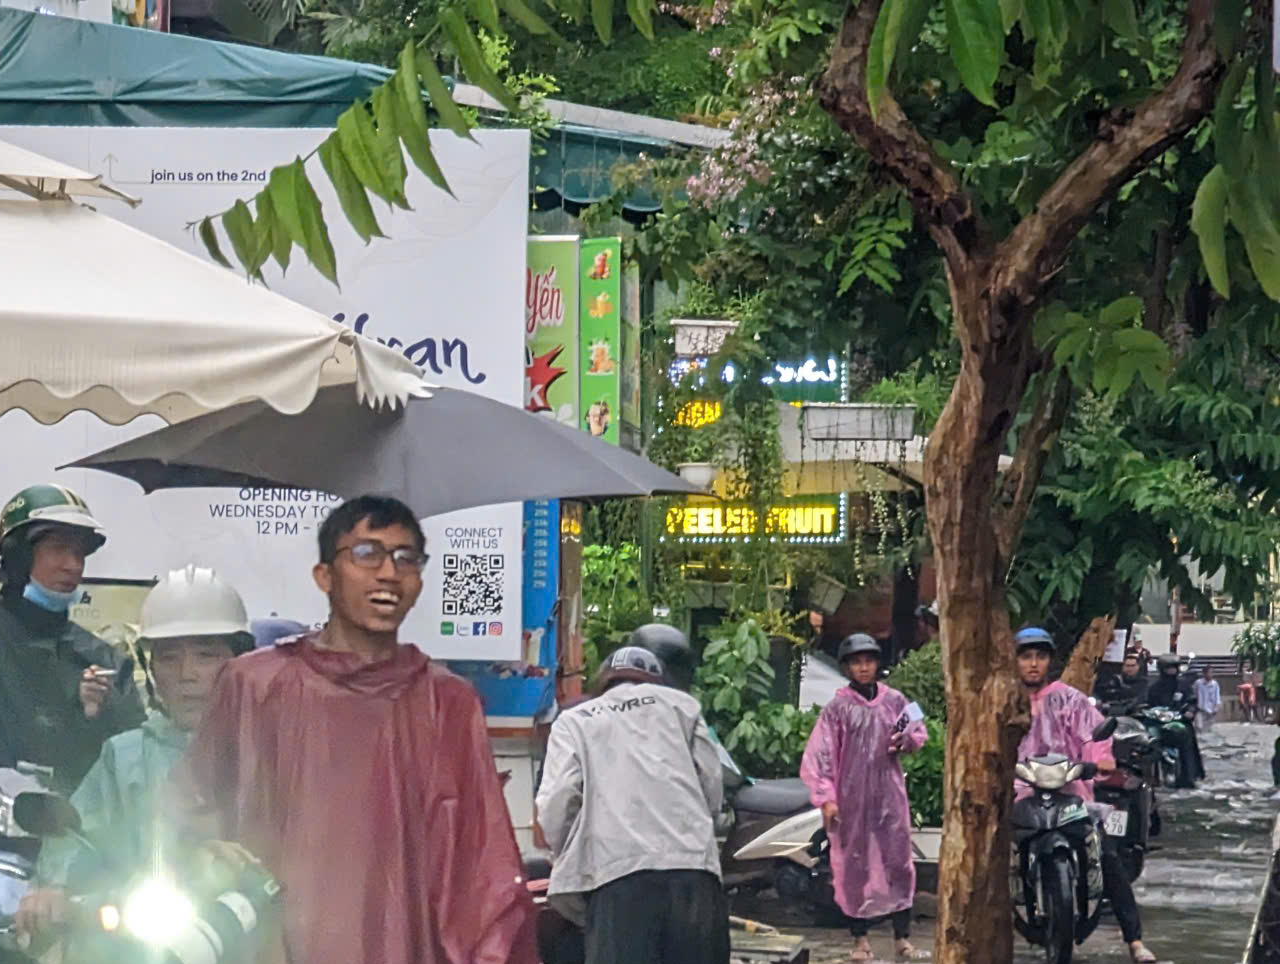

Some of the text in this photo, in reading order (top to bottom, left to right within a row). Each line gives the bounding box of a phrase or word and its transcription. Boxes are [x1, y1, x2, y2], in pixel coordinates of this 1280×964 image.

[150, 169, 266, 184] join us on the 2nd
[239, 487, 312, 501] OPENING
[209, 503, 307, 519] WEDNESDAY
[256, 520, 271, 535] 12
[274, 522, 299, 536] PM
[445, 527, 504, 538] CONNECT
[450, 538, 499, 549] WITH US
